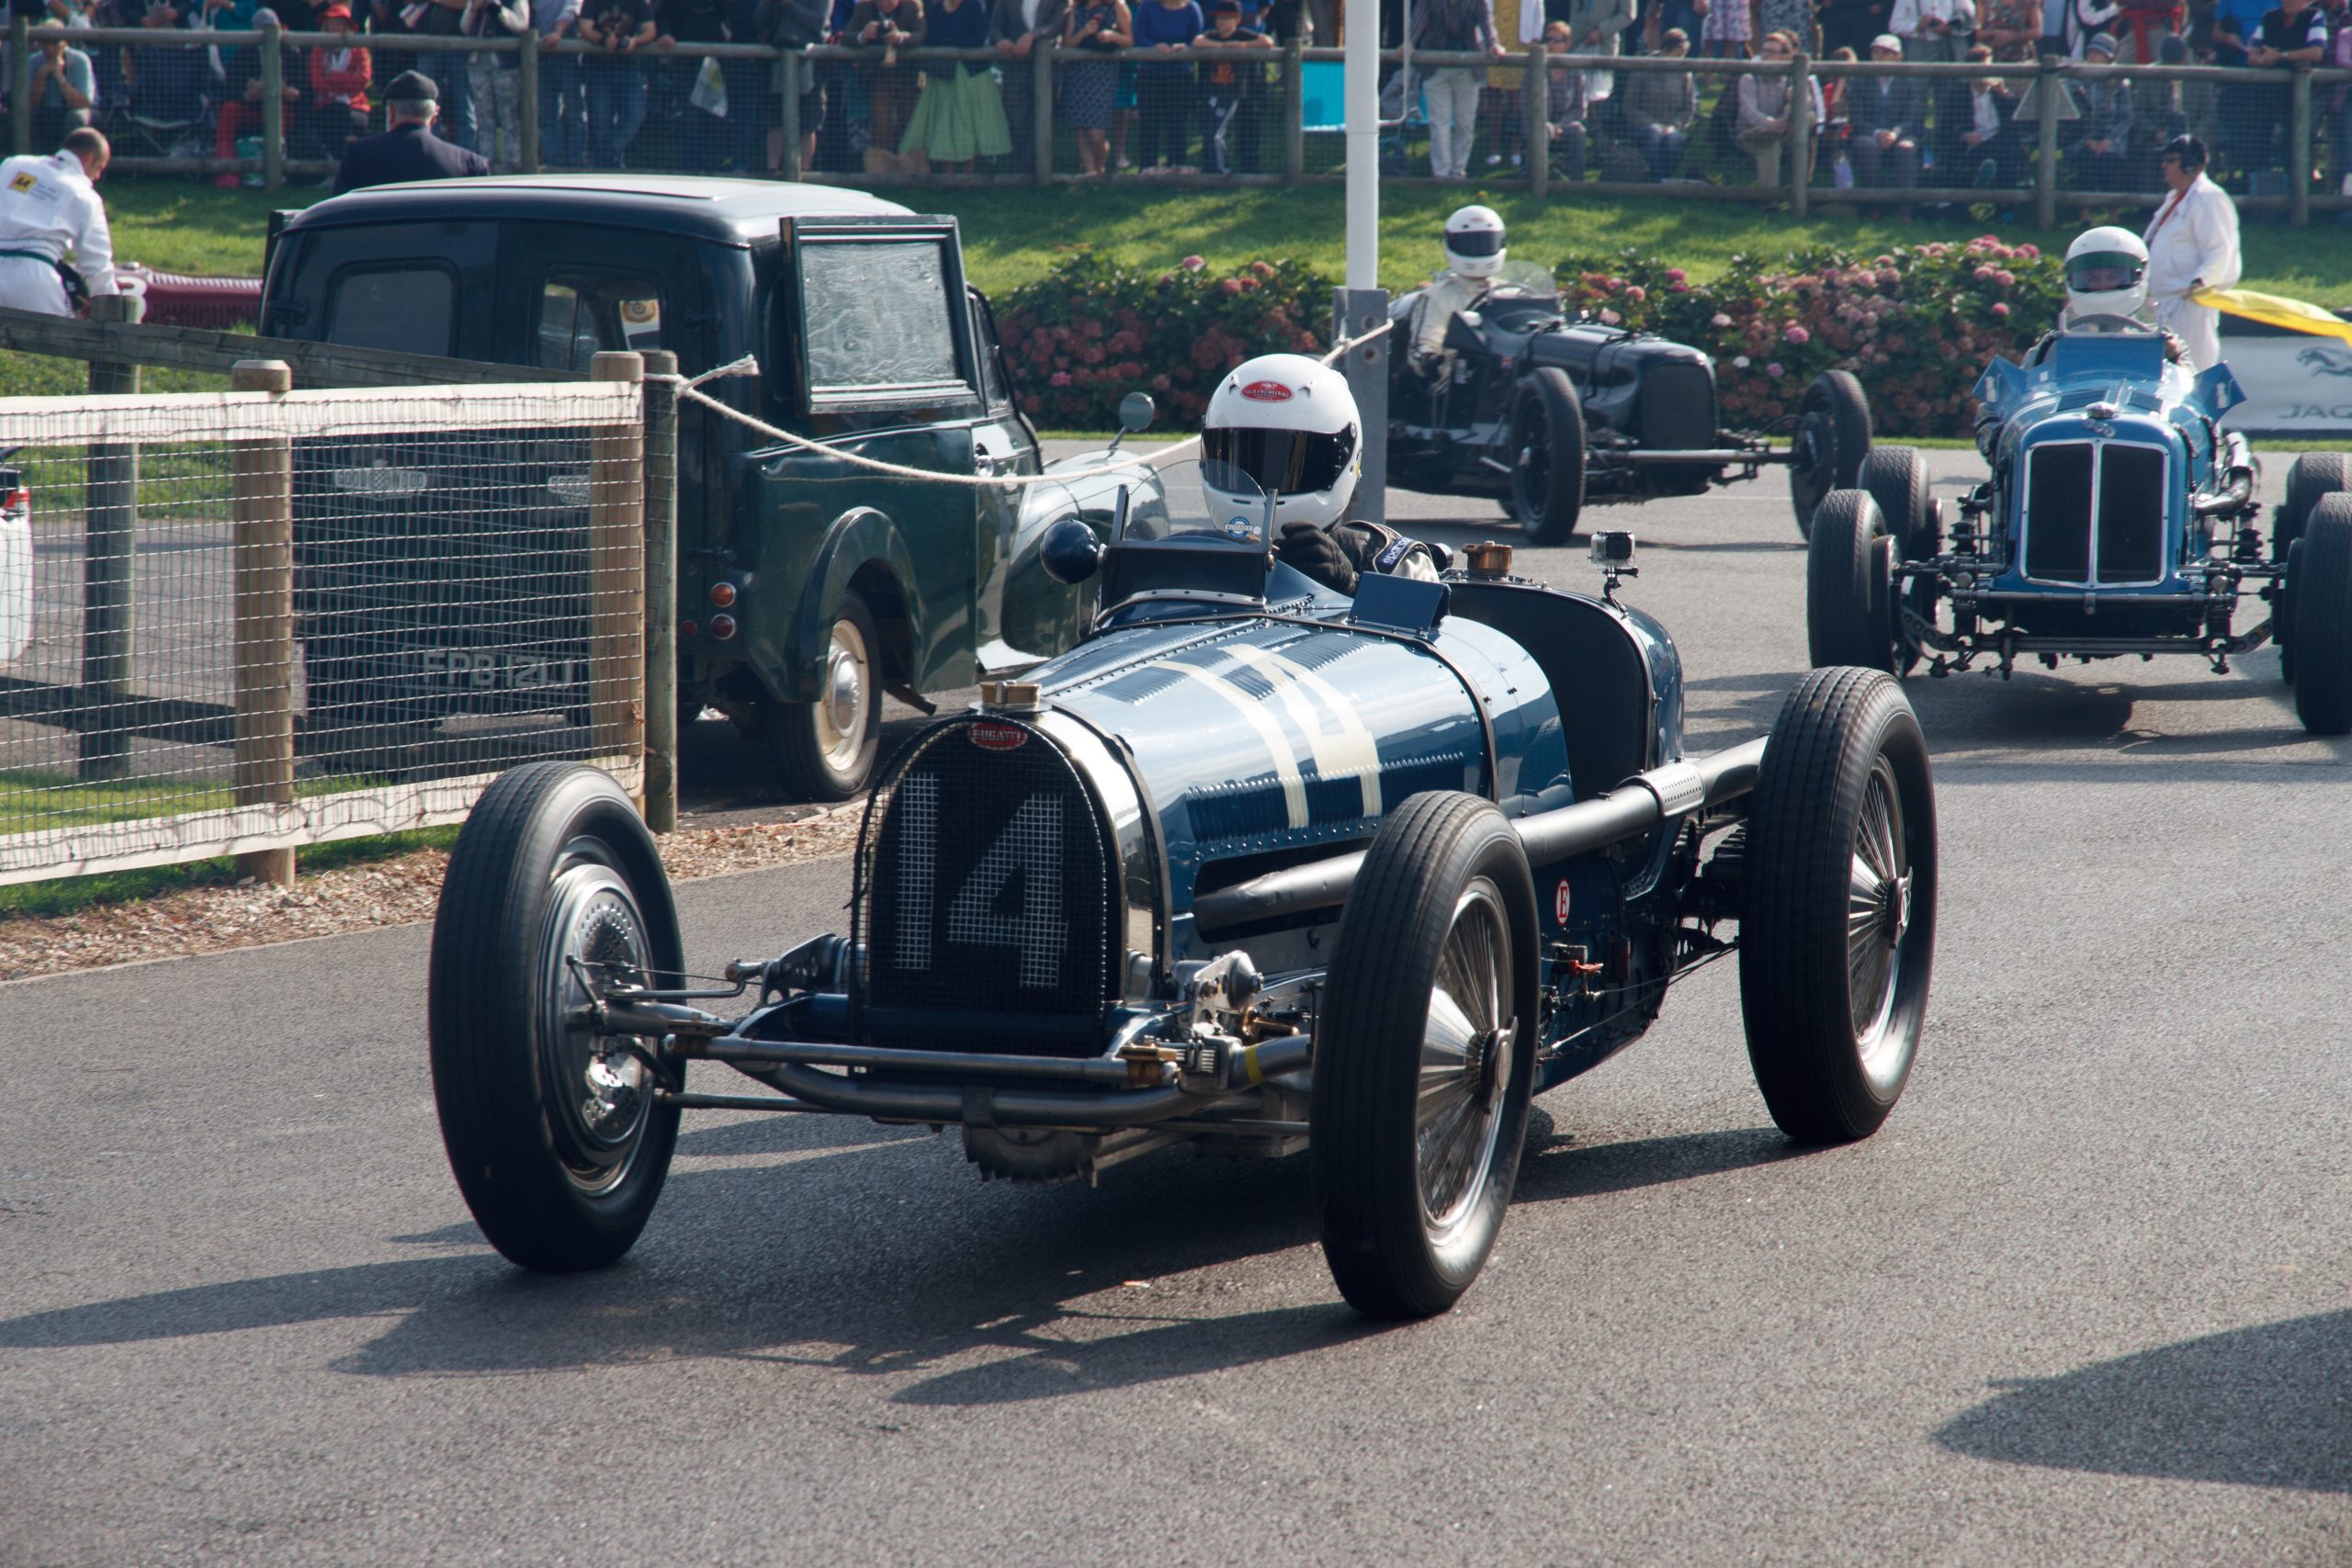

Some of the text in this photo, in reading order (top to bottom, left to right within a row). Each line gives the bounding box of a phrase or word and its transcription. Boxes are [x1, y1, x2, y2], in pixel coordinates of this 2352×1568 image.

[972, 728, 1022, 741] BUGATTI
[1147, 642, 1383, 829] 14
[895, 772, 1069, 988] 14
[1559, 886, 1568, 919] E
